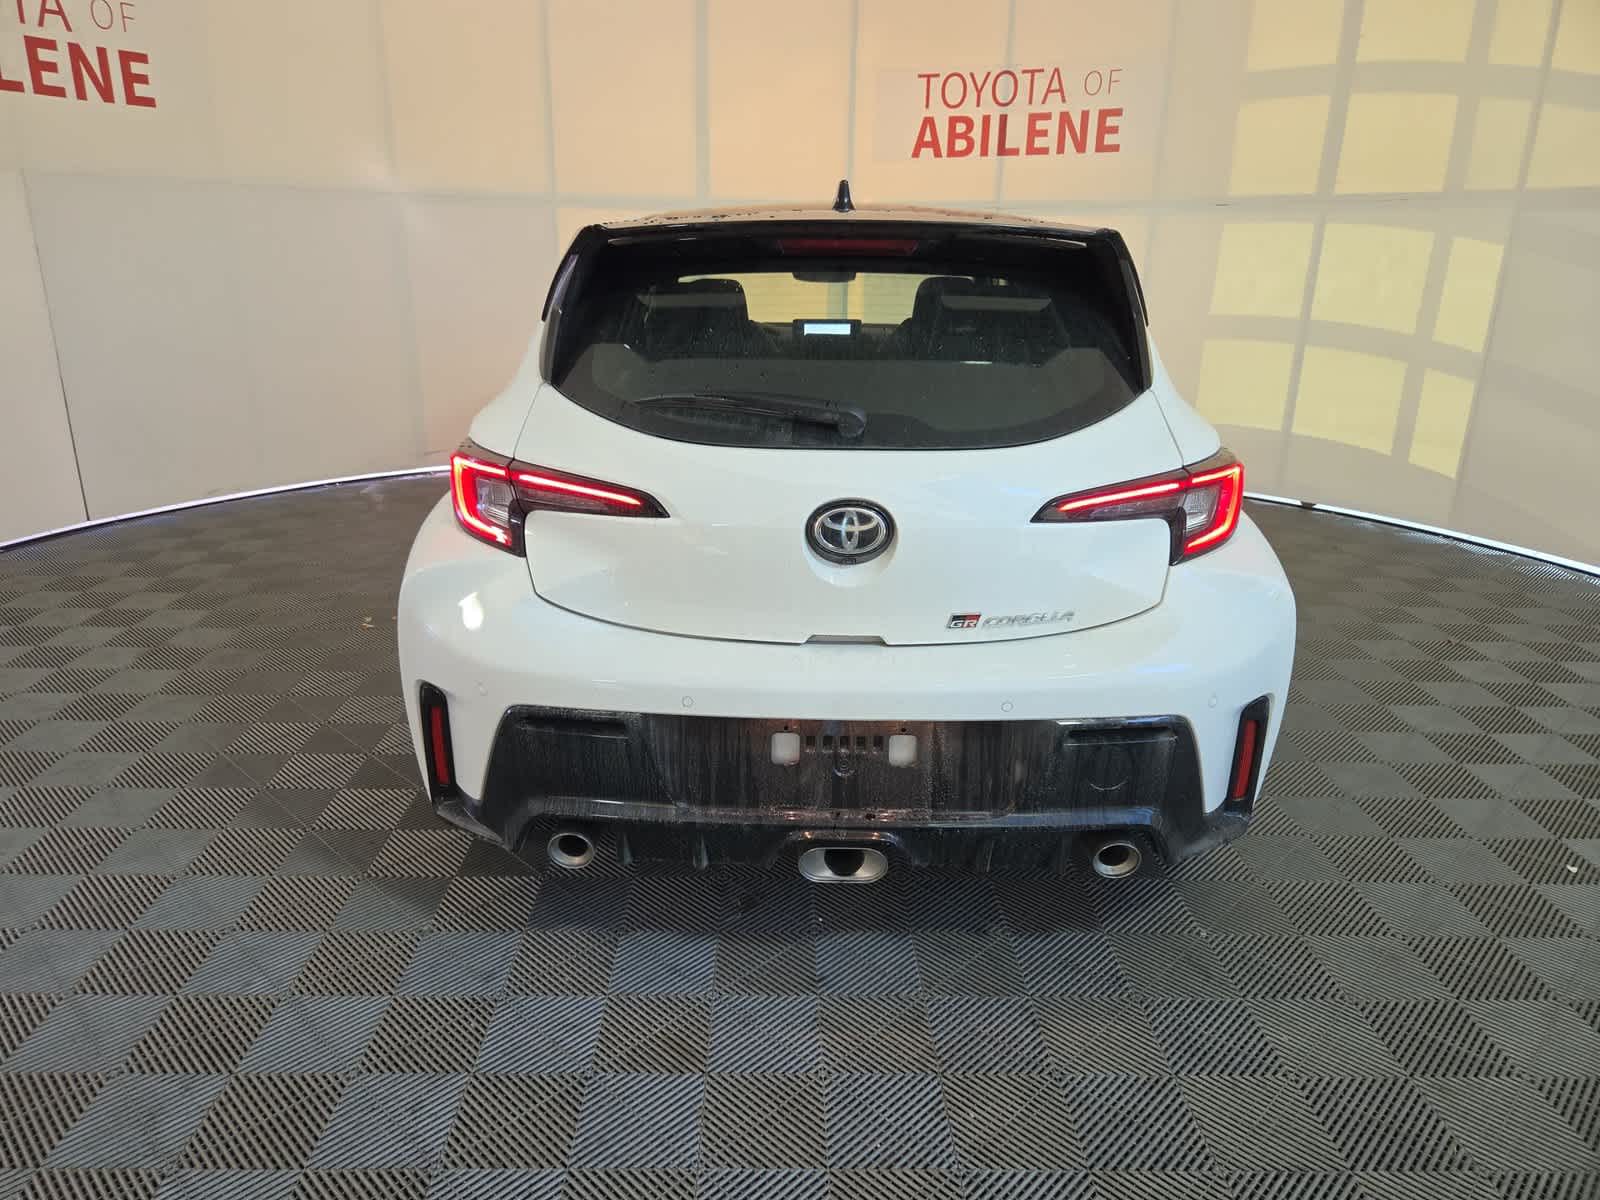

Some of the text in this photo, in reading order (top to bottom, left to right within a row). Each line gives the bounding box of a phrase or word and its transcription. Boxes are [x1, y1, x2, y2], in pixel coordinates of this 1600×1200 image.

[91, 0, 135, 32] OF
[917, 67, 1123, 109] TOYOTA OF
[911, 108, 1124, 159] ABILENE
[950, 617, 980, 629] GR
